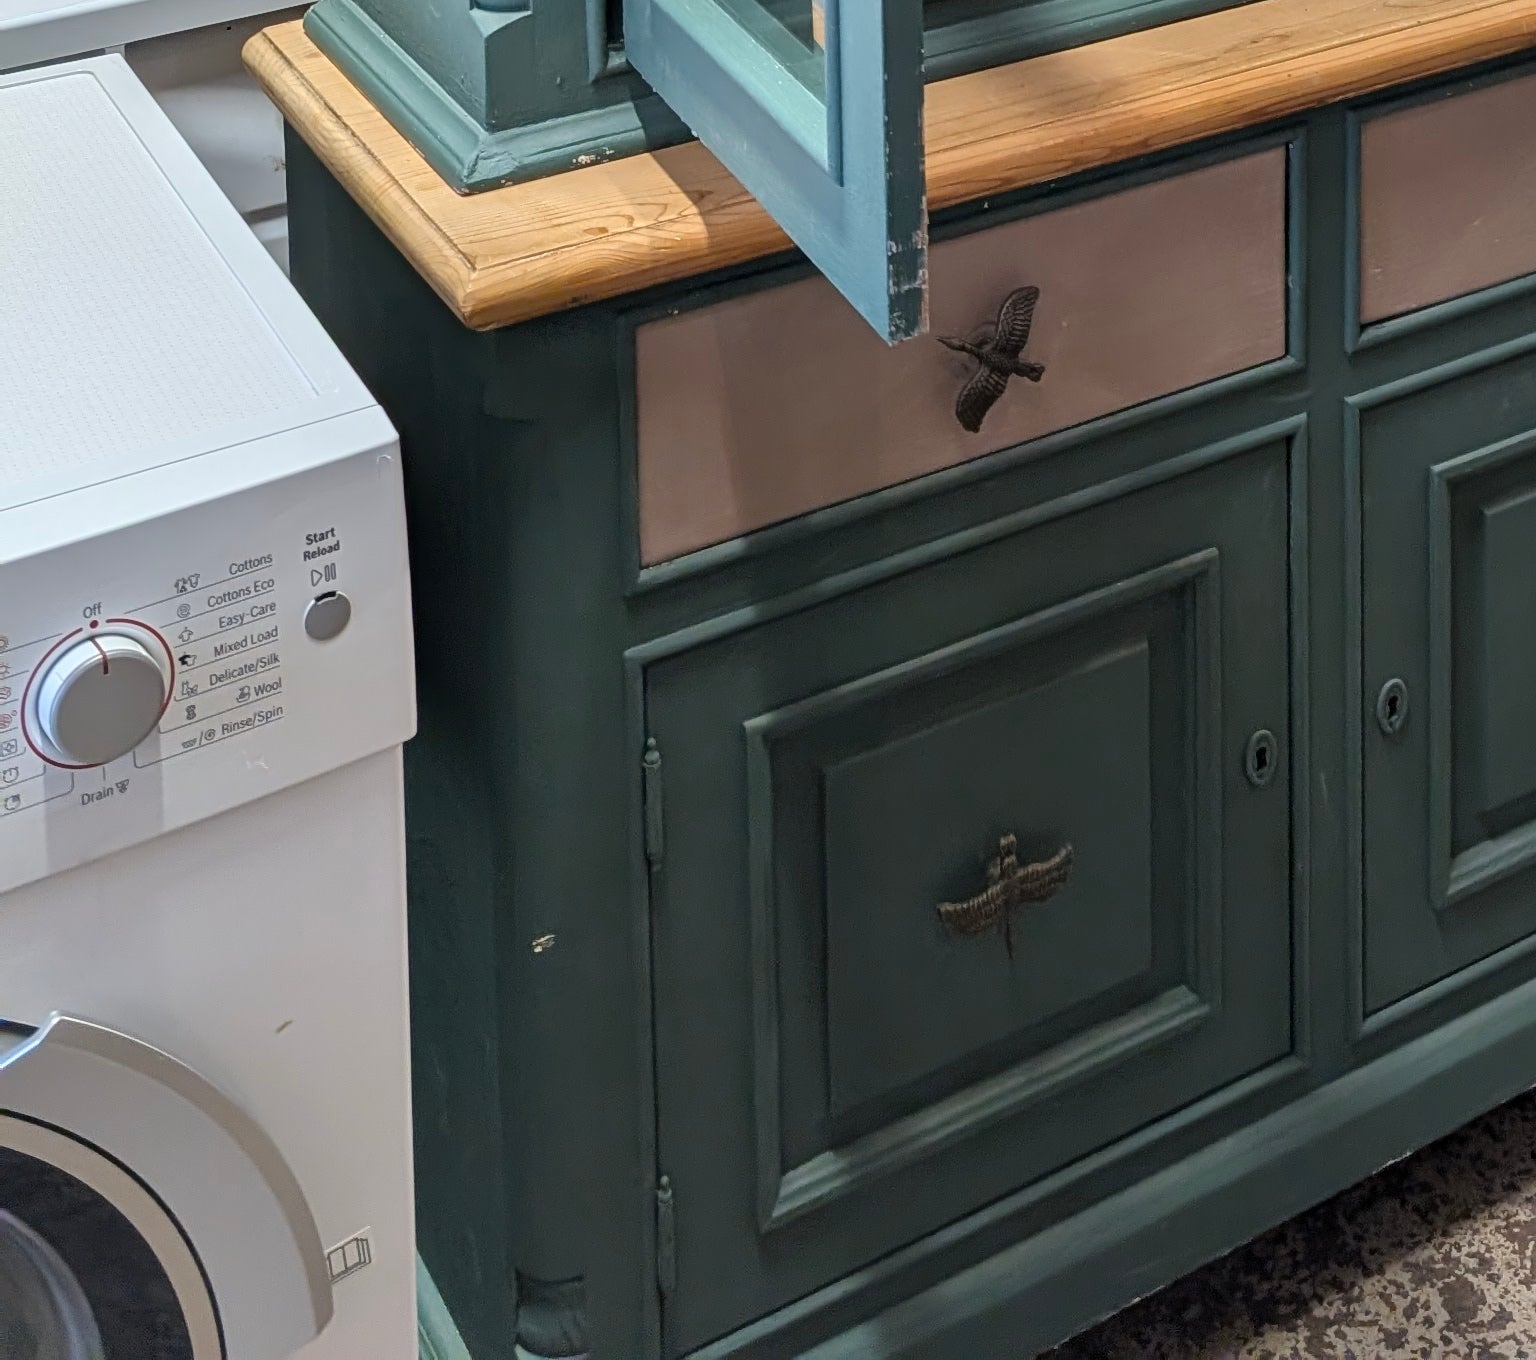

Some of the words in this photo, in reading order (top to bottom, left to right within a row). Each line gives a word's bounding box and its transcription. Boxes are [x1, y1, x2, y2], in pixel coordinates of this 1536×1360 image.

[305, 527, 336, 546] Start
[303, 540, 340, 561] Reload
[229, 553, 273, 575] Cottons
[207, 585, 252, 608] Cottons
[253, 578, 275, 593] Eco
[83, 602, 103, 619] Off
[218, 601, 276, 628] Easy-Care
[213, 635, 248, 657] Mixed
[250, 625, 279, 645] Load
[209, 652, 280, 686] Delicate/Silk
[253, 676, 282, 696] Wool
[221, 706, 284, 735] Rinse/Spin
[81, 785, 114, 806] Drain
